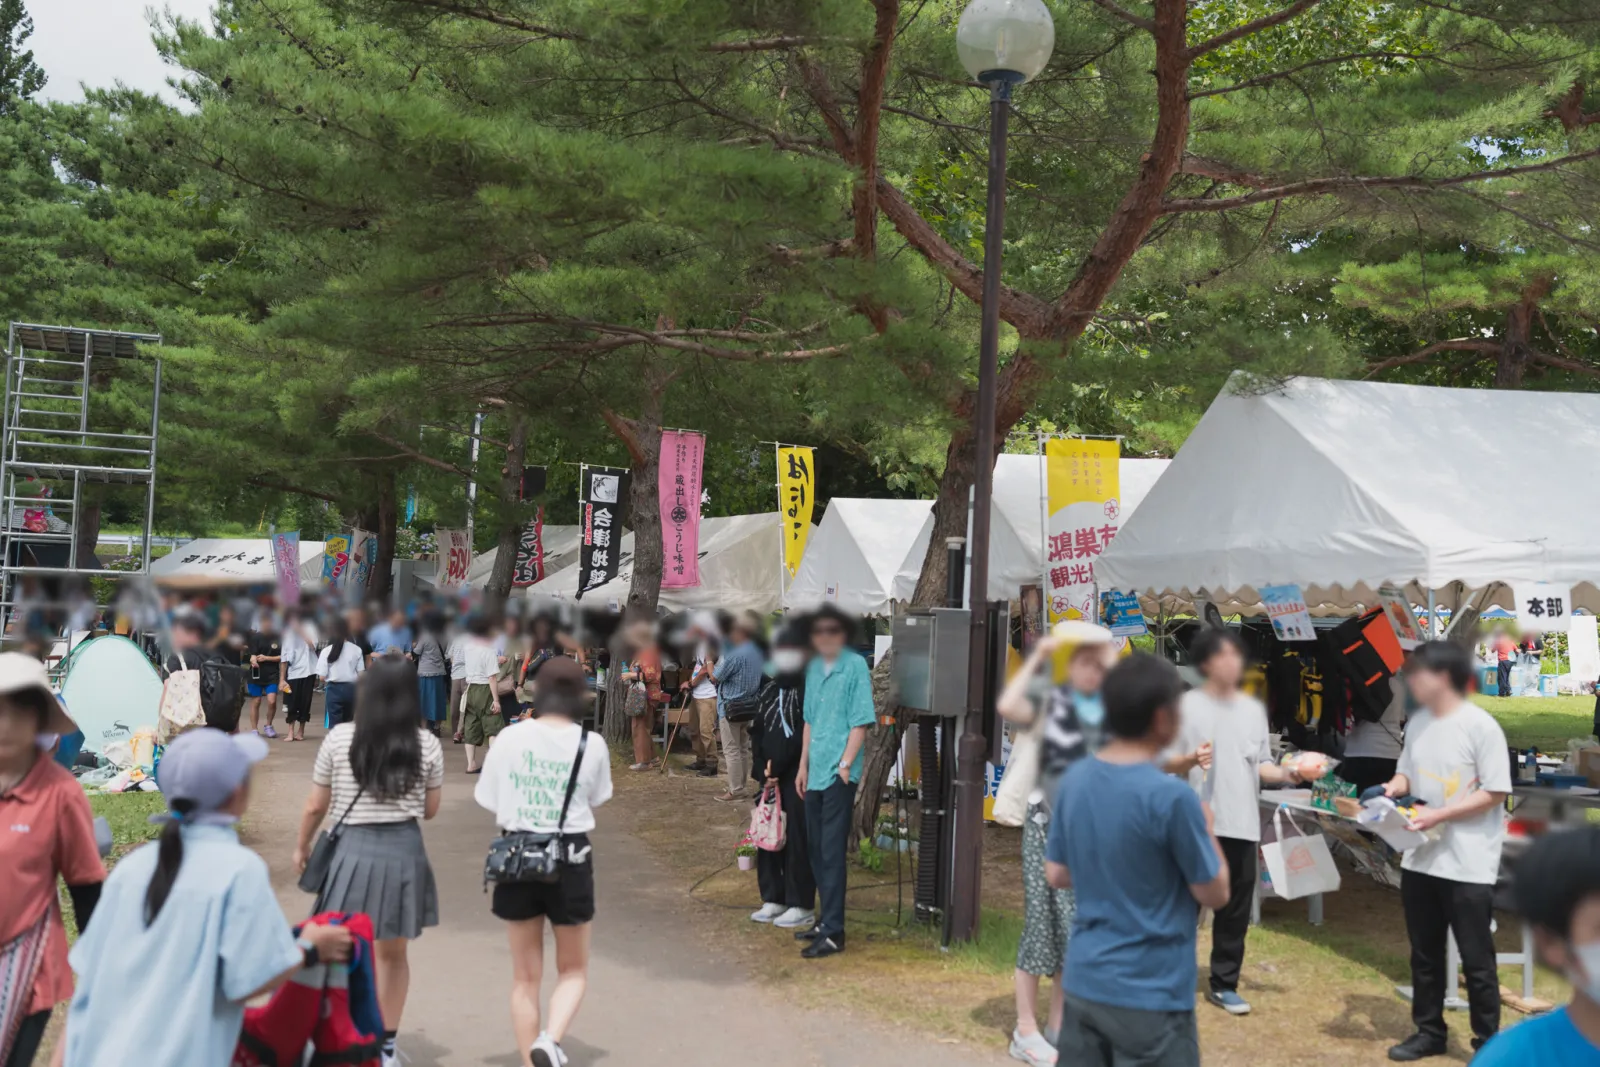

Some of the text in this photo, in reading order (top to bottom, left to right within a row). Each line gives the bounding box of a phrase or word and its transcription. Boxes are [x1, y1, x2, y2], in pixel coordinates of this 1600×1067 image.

[673, 474, 685, 575] 蔵出し こうじ味噌
[1048, 524, 1118, 562] 鴻巣市
[1527, 597, 1563, 618] 本部
[520, 751, 571, 775] Accept
